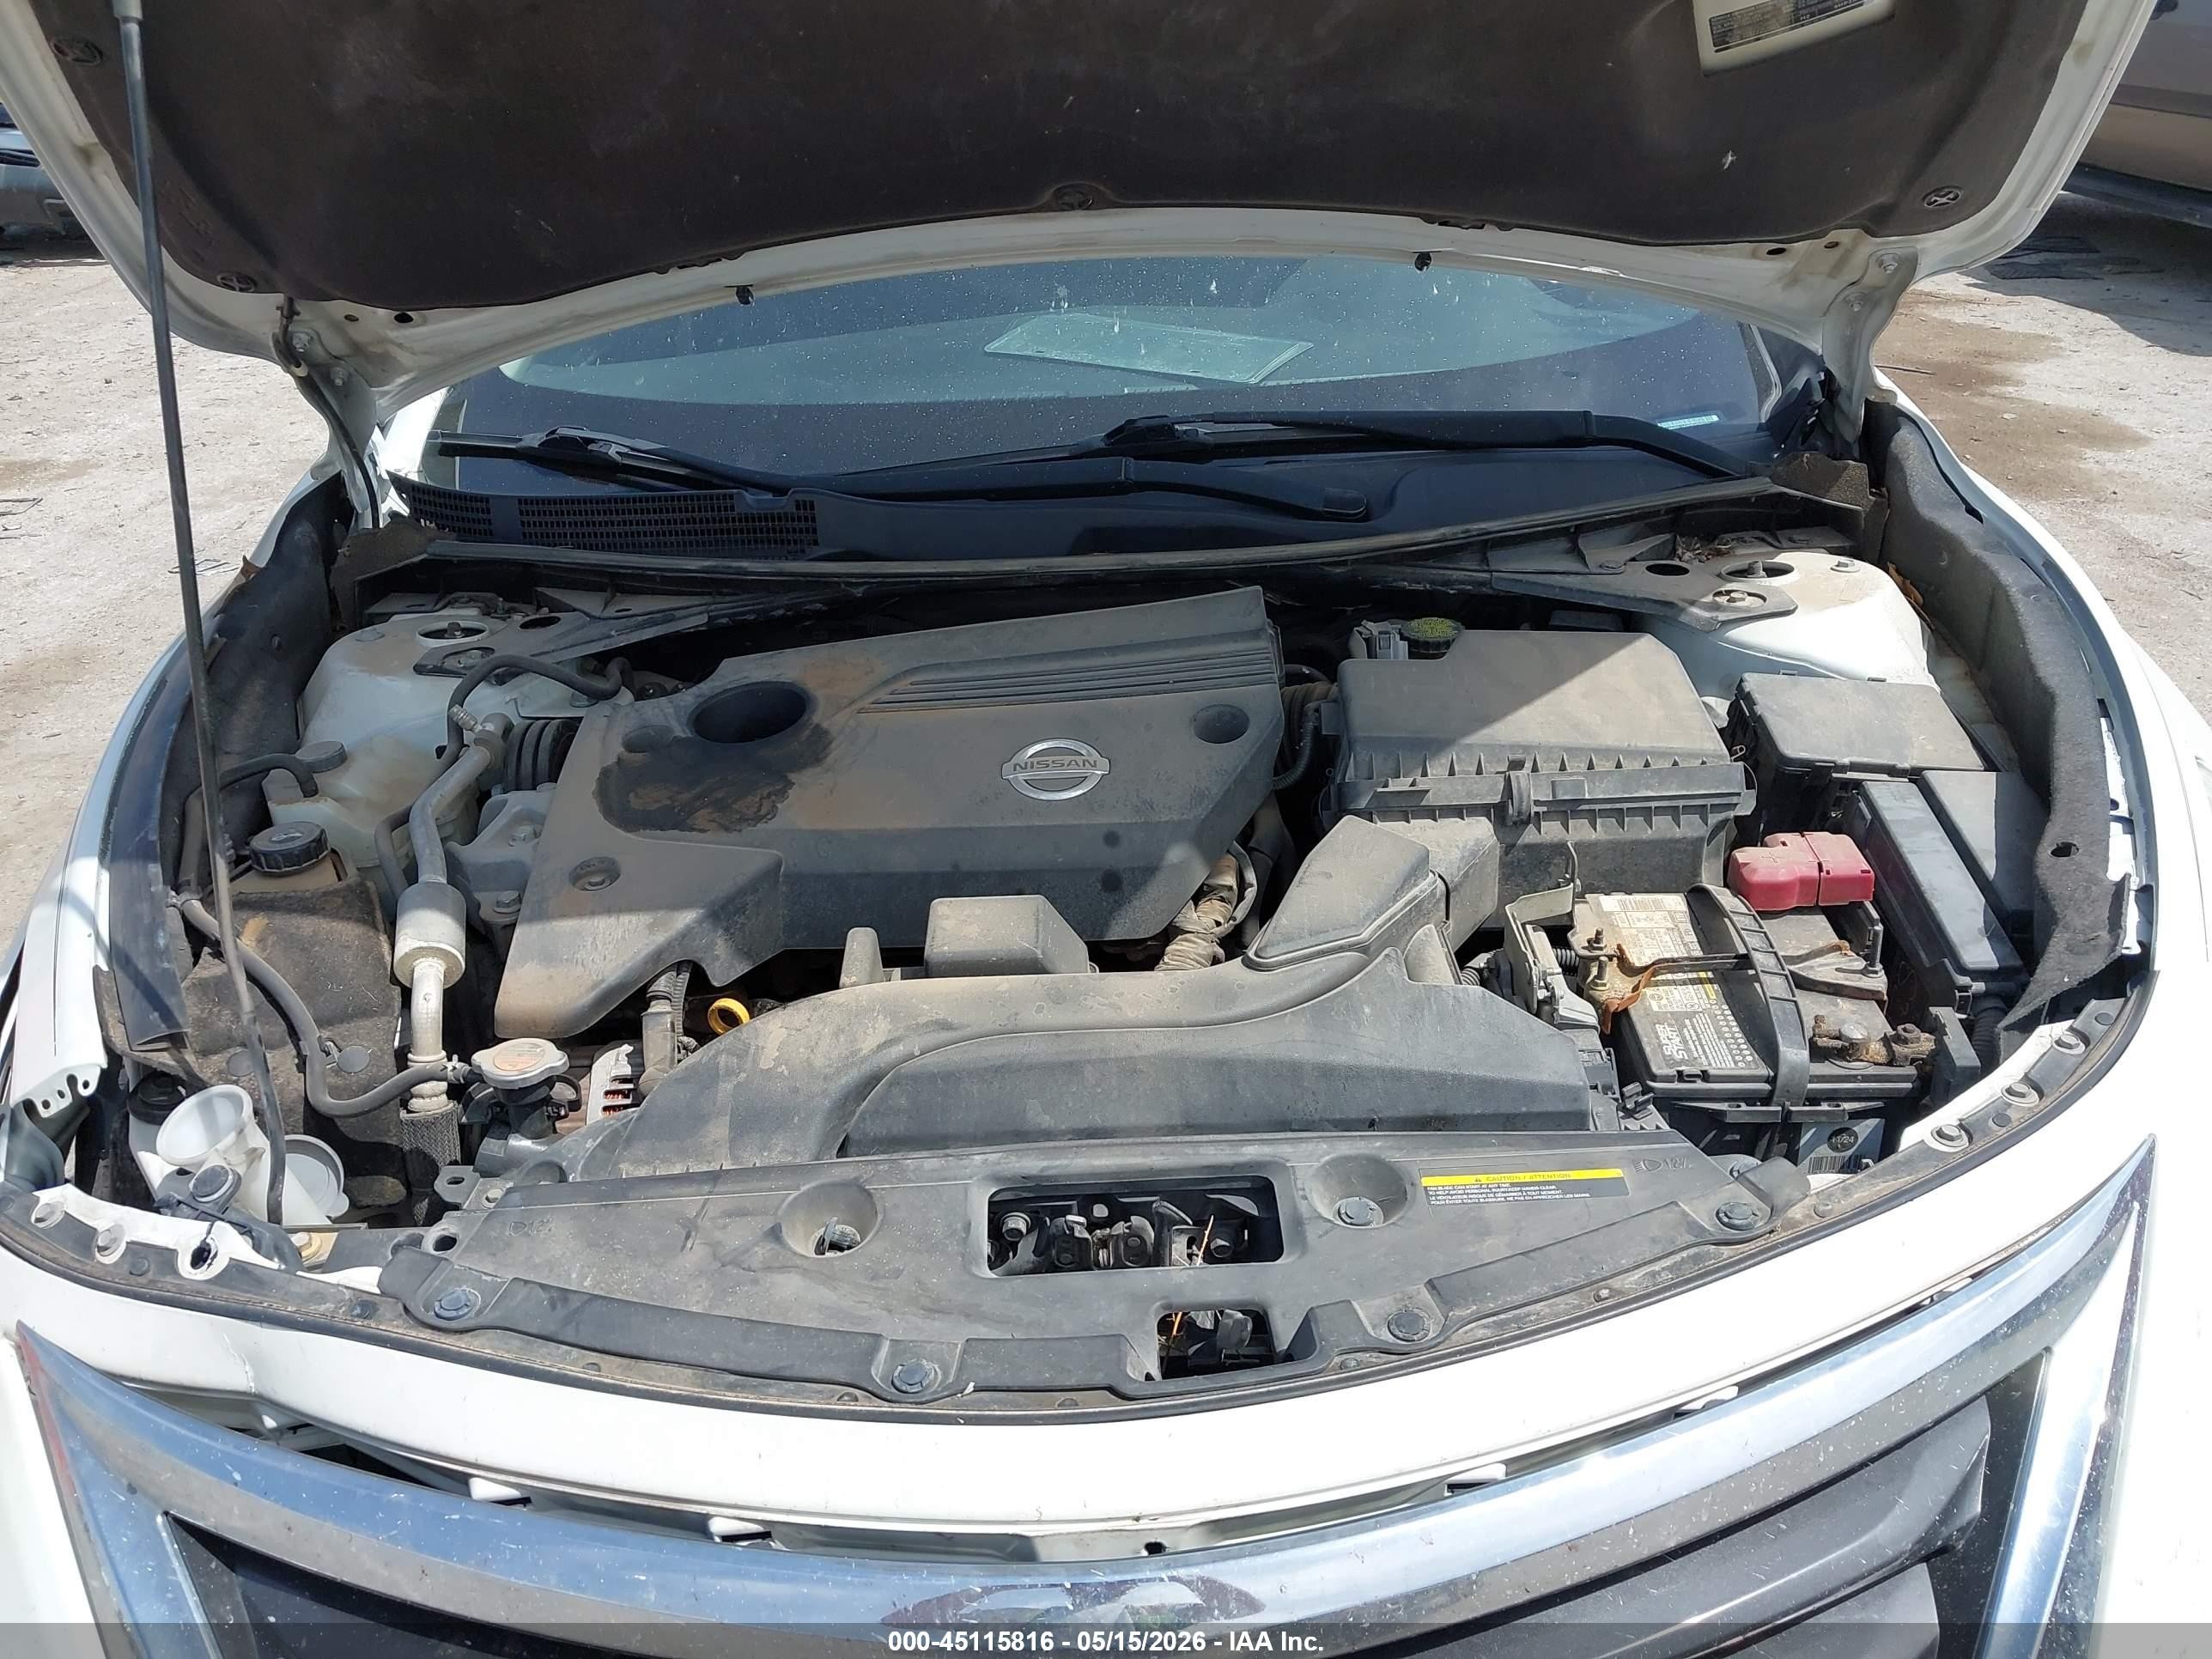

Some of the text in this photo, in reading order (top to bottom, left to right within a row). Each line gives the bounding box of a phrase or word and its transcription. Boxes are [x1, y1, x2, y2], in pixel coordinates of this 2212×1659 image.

[1013, 758, 1097, 772] NISSAN
[1655, 1023, 1674, 1055] SUPER
[1667, 1024, 1689, 1060] START
